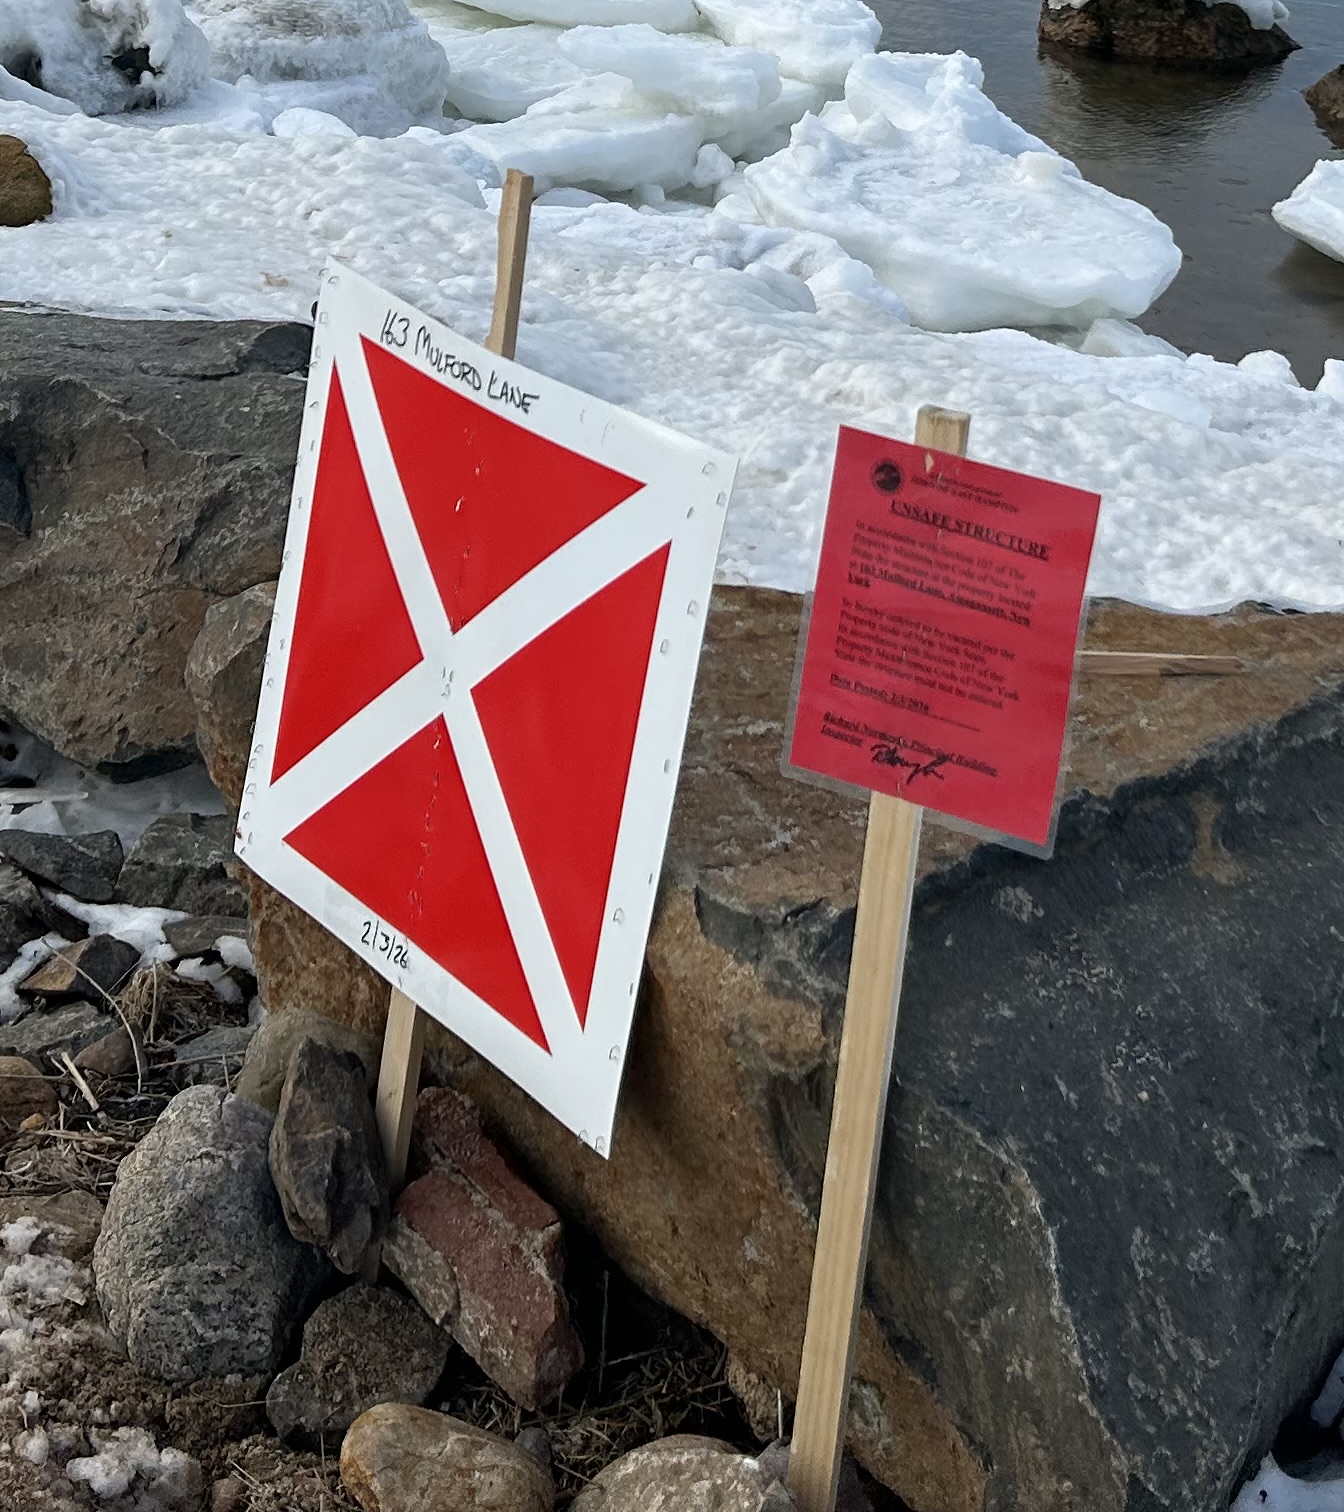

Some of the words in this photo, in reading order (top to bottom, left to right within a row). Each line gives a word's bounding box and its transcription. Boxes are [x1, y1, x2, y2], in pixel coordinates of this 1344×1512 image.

[380, 309, 410, 348] 163
[414, 326, 482, 391] MULFORD
[487, 370, 540, 414] LANE
[889, 498, 951, 530] UNSAFE
[953, 517, 1051, 561] STRUCTURE
[361, 920, 409, 969] 2/3/26
